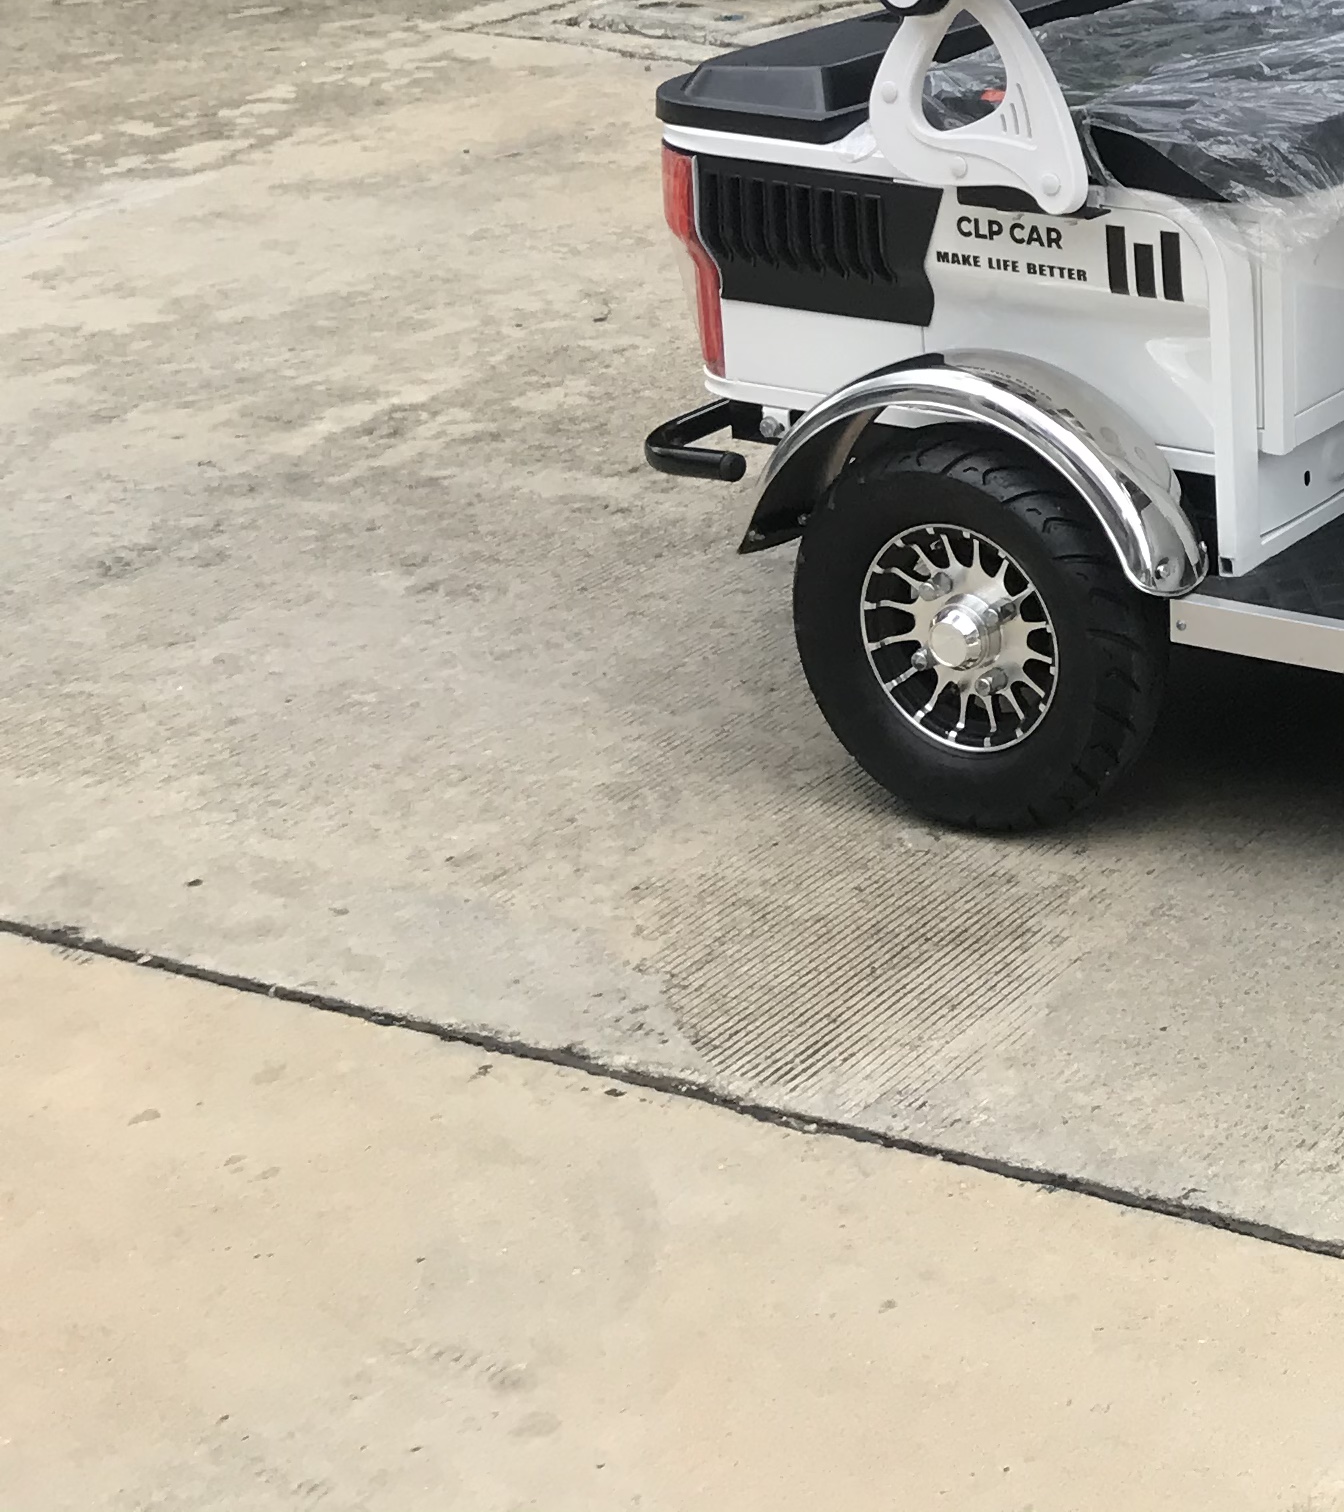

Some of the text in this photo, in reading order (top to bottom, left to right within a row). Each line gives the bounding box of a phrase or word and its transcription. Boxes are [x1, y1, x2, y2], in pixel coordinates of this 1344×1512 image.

[956, 215, 1063, 250] CLP CAR
[936, 250, 1088, 282] MAKE LIFE BETTER
